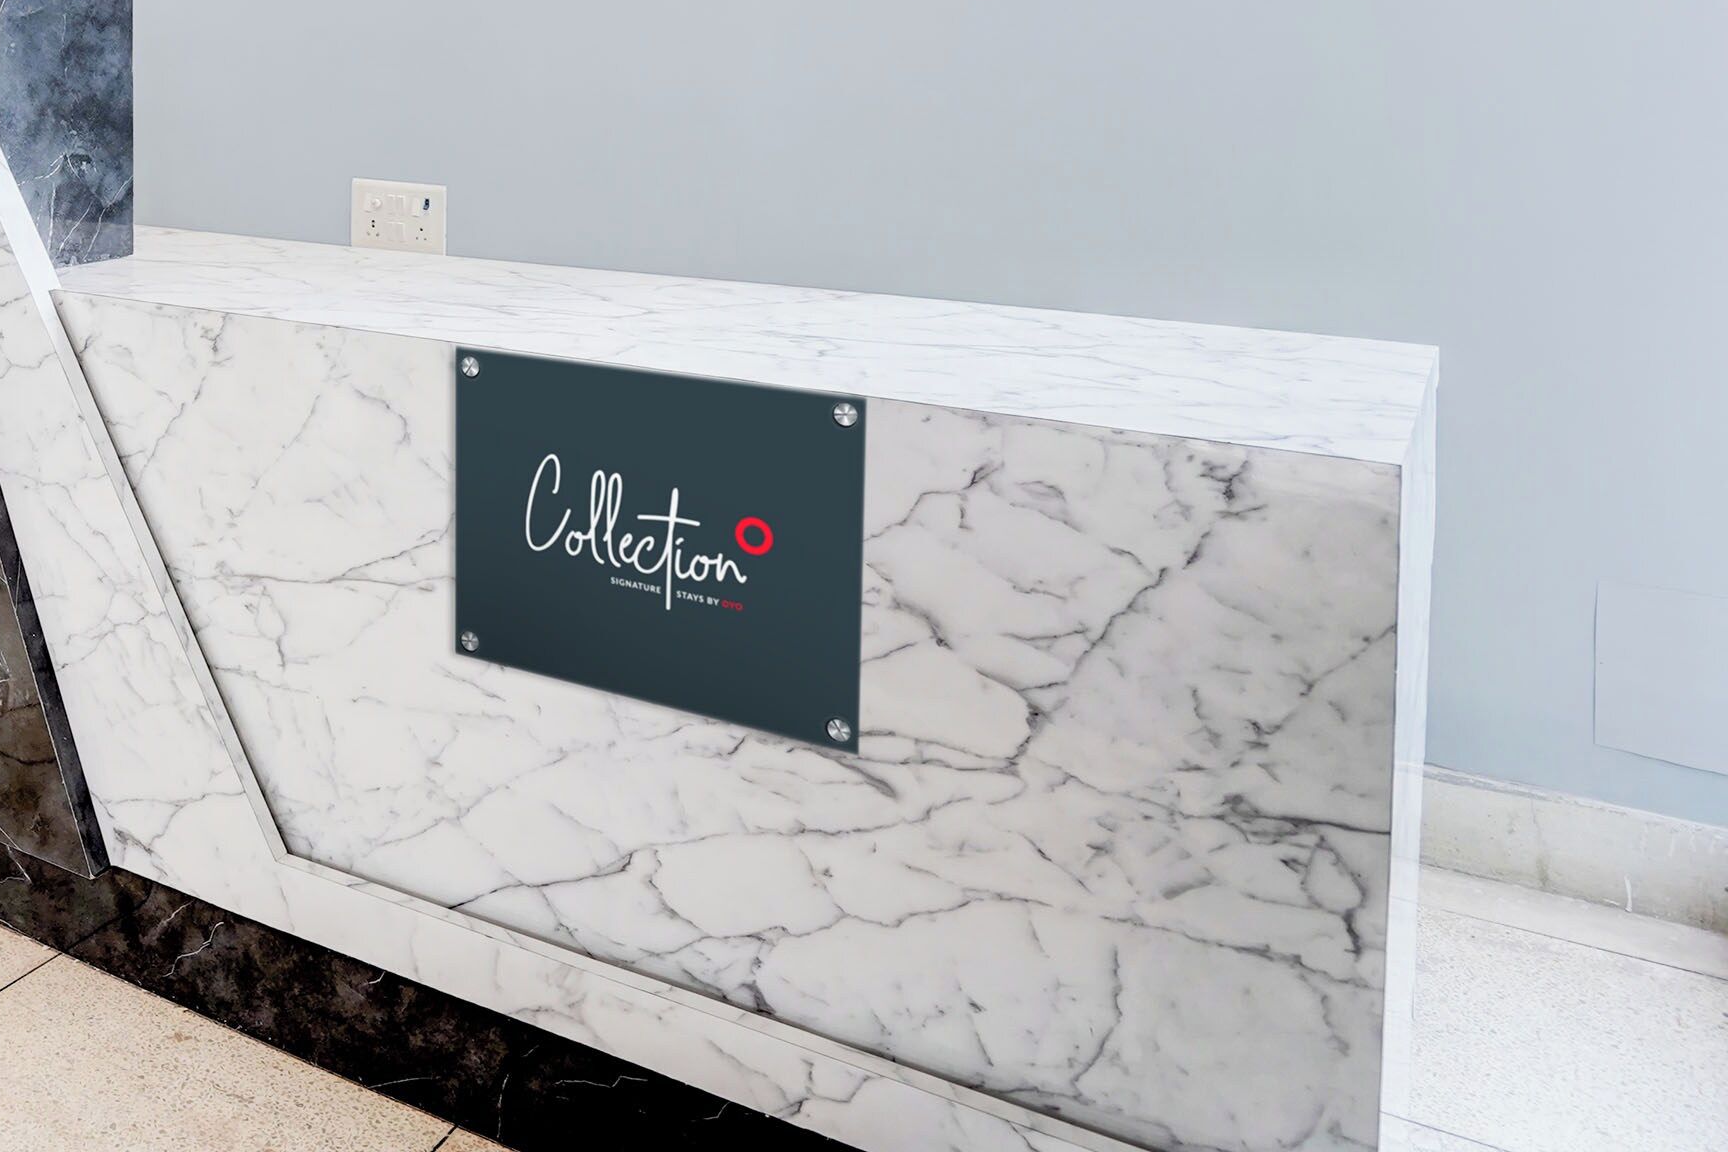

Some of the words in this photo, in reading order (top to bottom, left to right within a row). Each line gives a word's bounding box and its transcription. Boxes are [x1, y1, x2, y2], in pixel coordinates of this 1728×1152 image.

[525, 453, 747, 610] Collection
[610, 576, 662, 594] SIGNATURE
[676, 590, 705, 604] STAYS
[706, 596, 720, 606] BY
[721, 599, 743, 612] OYO
